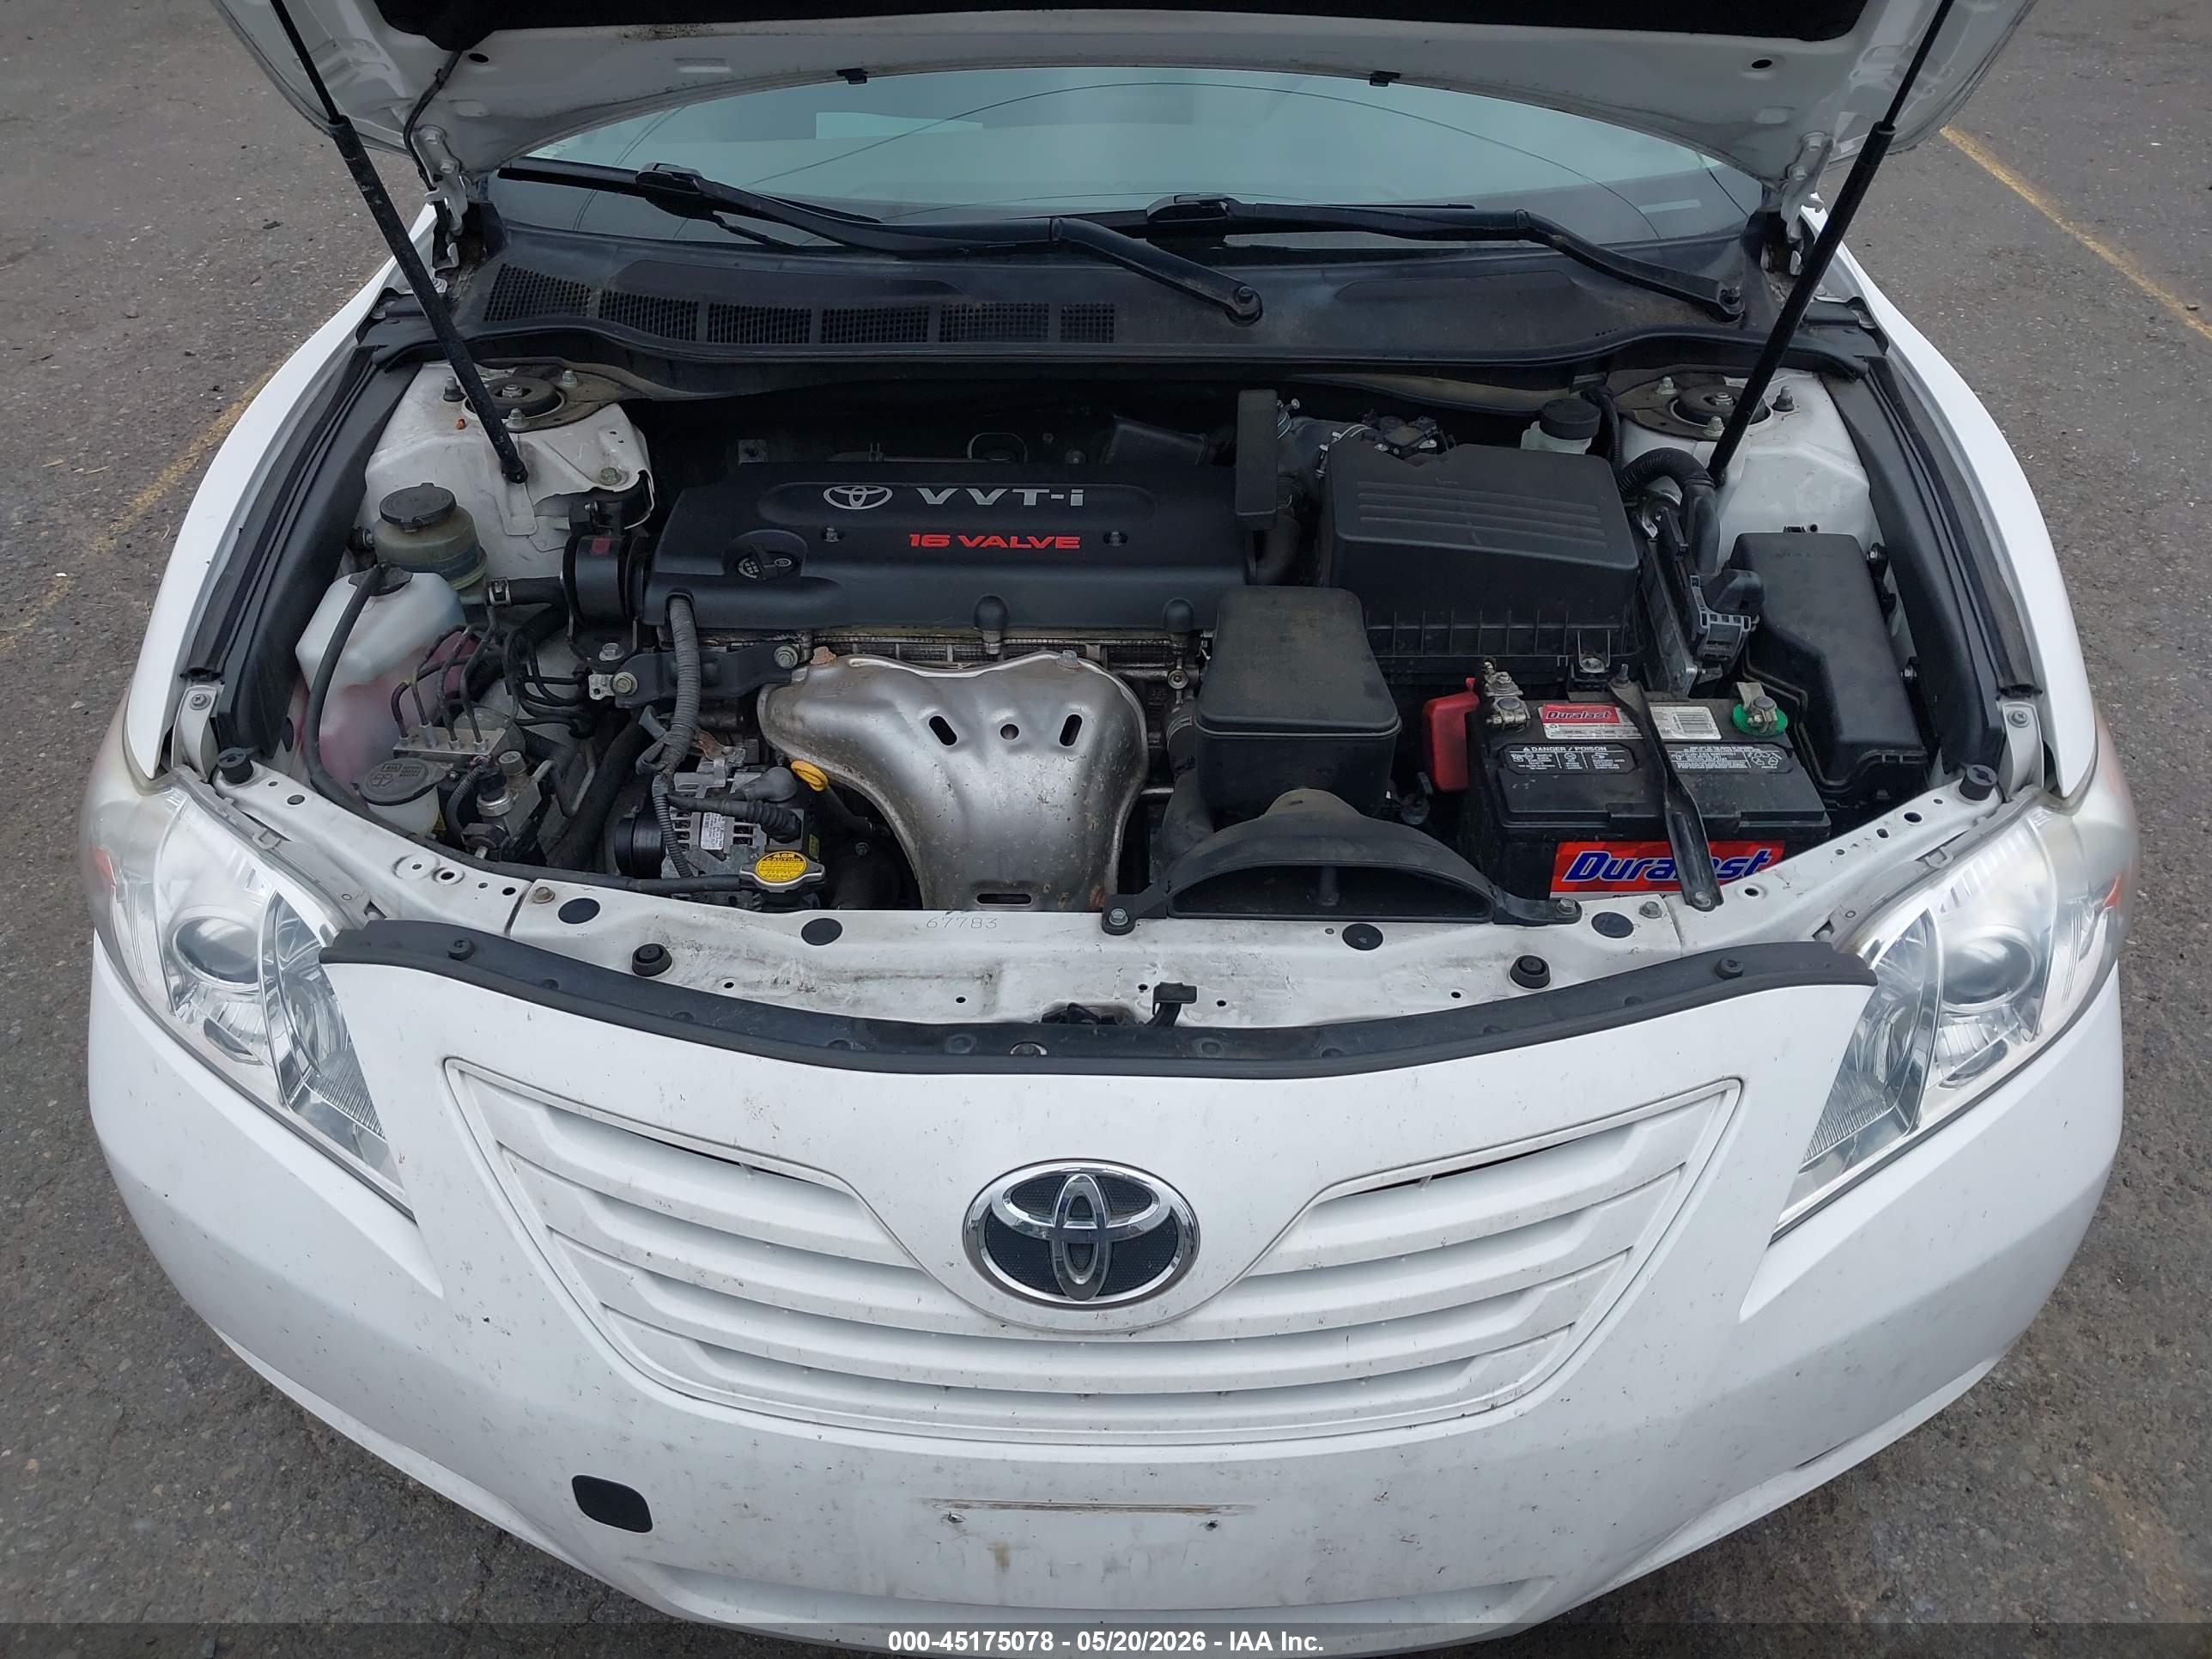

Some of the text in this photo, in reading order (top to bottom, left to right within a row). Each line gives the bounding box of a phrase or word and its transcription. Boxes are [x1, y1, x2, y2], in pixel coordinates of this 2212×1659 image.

[916, 488, 1084, 507] VVT-i
[909, 534, 1081, 549] 16 VALVE
[1546, 710, 1612, 720] Duralast
[1561, 848, 1772, 883] Durast
